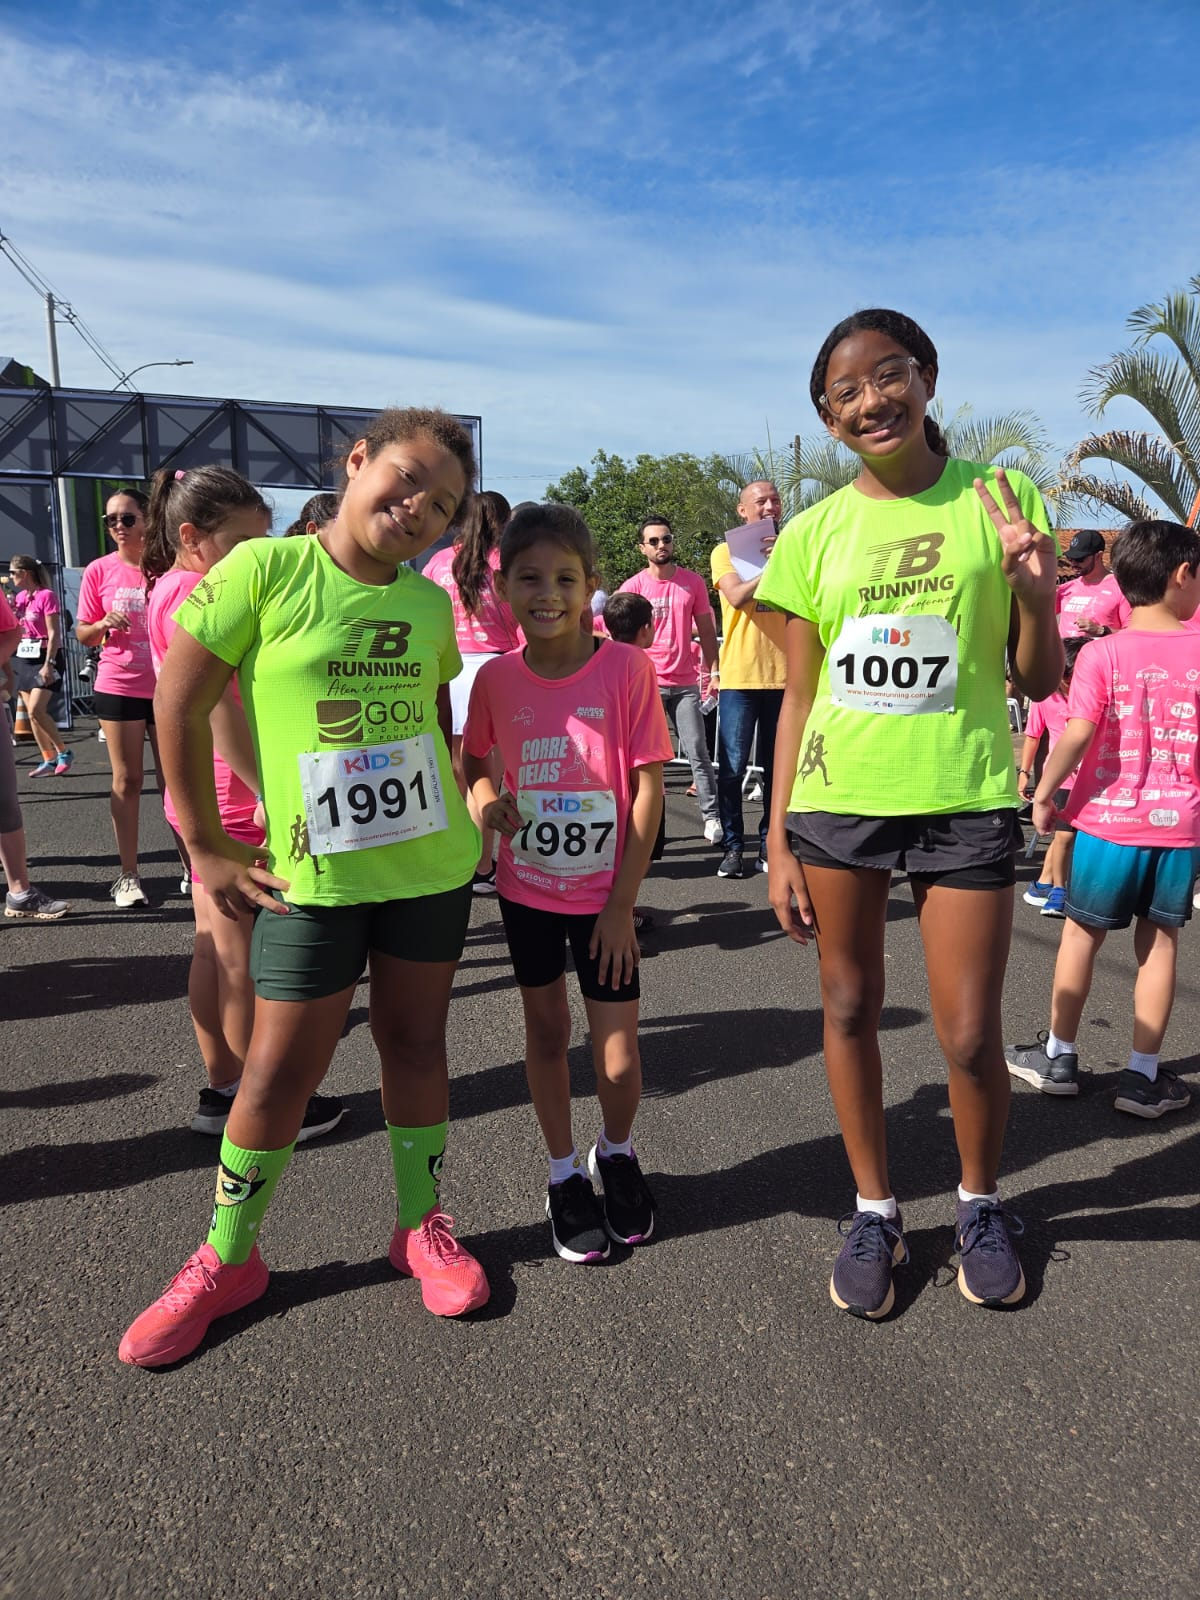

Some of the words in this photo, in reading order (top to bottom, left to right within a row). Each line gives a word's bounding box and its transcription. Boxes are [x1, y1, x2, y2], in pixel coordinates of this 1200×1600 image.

[858, 574, 954, 603] RUNNING
[871, 626, 912, 647] KIDS
[327, 660, 422, 678] RUNNING
[836, 653, 950, 689] 1007
[343, 749, 404, 775] KIDS
[521, 735, 570, 763] CORRE
[518, 761, 561, 787] DELAS
[317, 770, 428, 828] 1991
[541, 792, 594, 813] KIDS
[519, 820, 615, 857] 1987
